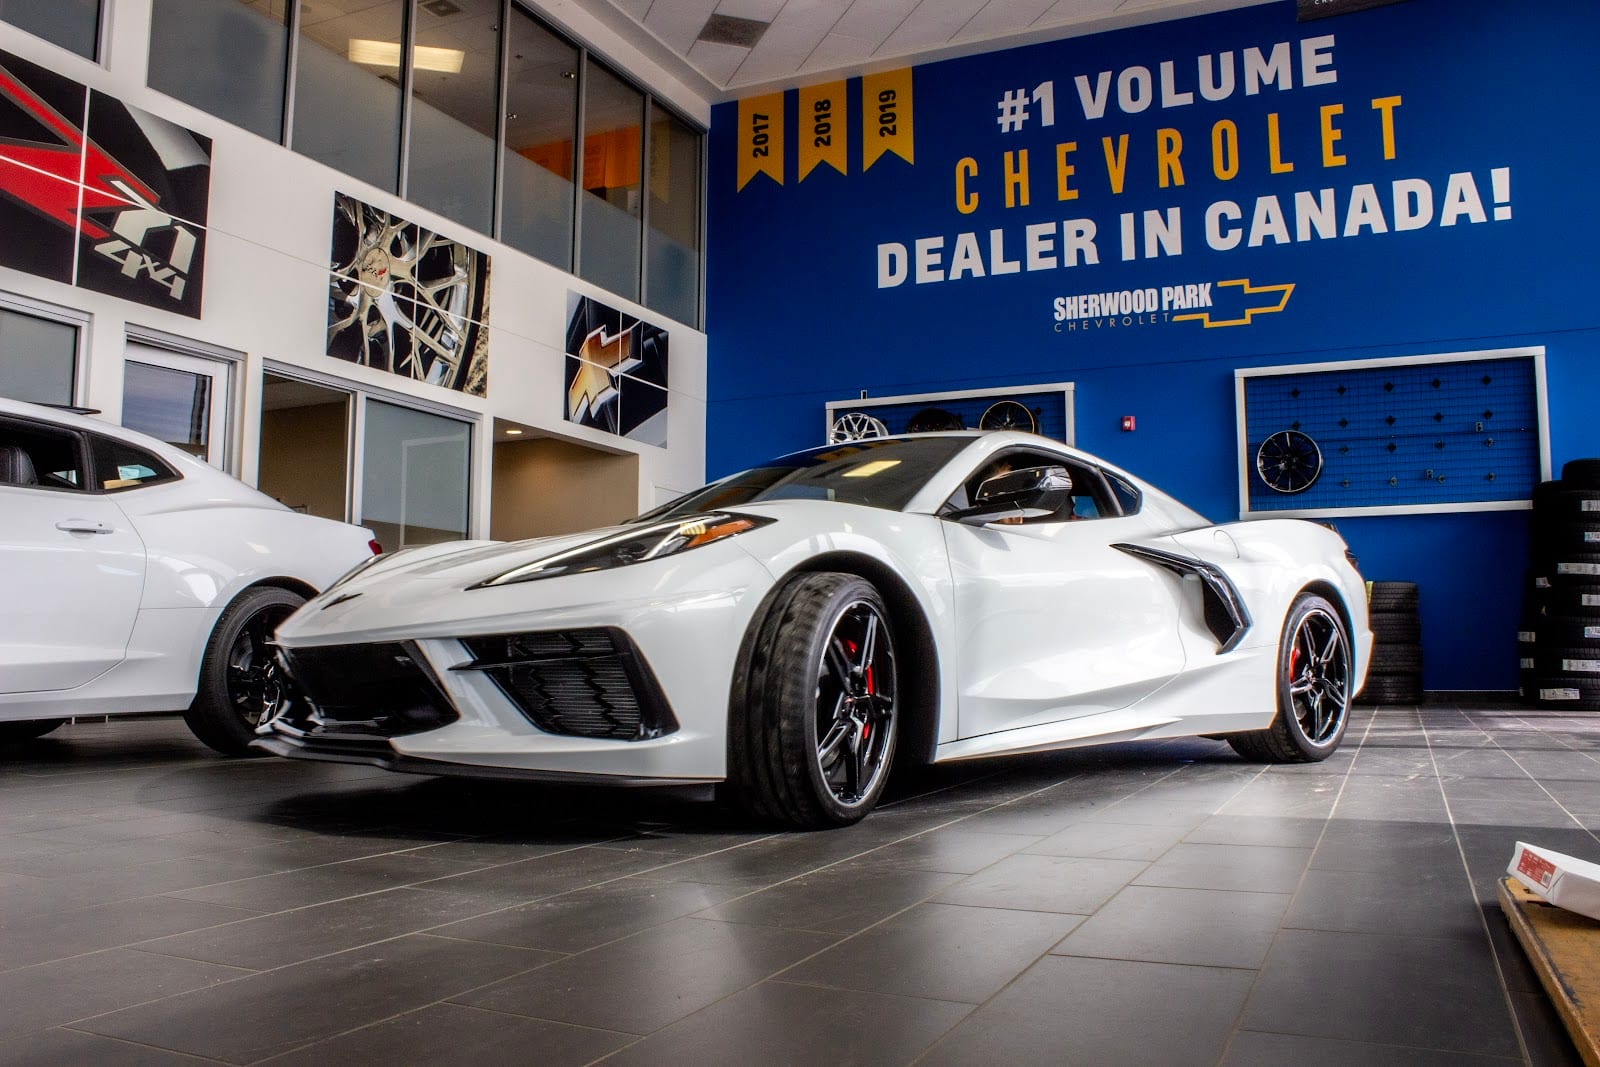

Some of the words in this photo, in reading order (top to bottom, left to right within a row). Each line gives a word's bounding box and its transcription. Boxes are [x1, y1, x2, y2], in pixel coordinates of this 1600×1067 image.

[997, 80, 1055, 133] #1
[1074, 34, 1338, 120] VOLUME
[752, 113, 769, 158] 2017
[814, 99, 831, 148] 2018
[878, 89, 897, 137] 2019
[955, 95, 1402, 215] CHEVROLET
[877, 218, 1100, 288] DEALER
[1120, 206, 1183, 261] IN
[1205, 167, 1512, 251] CANADA!
[1053, 288, 1158, 321] SHERWOOD
[1162, 282, 1213, 309] PARK
[1053, 312, 1170, 333] CHEVROLET
